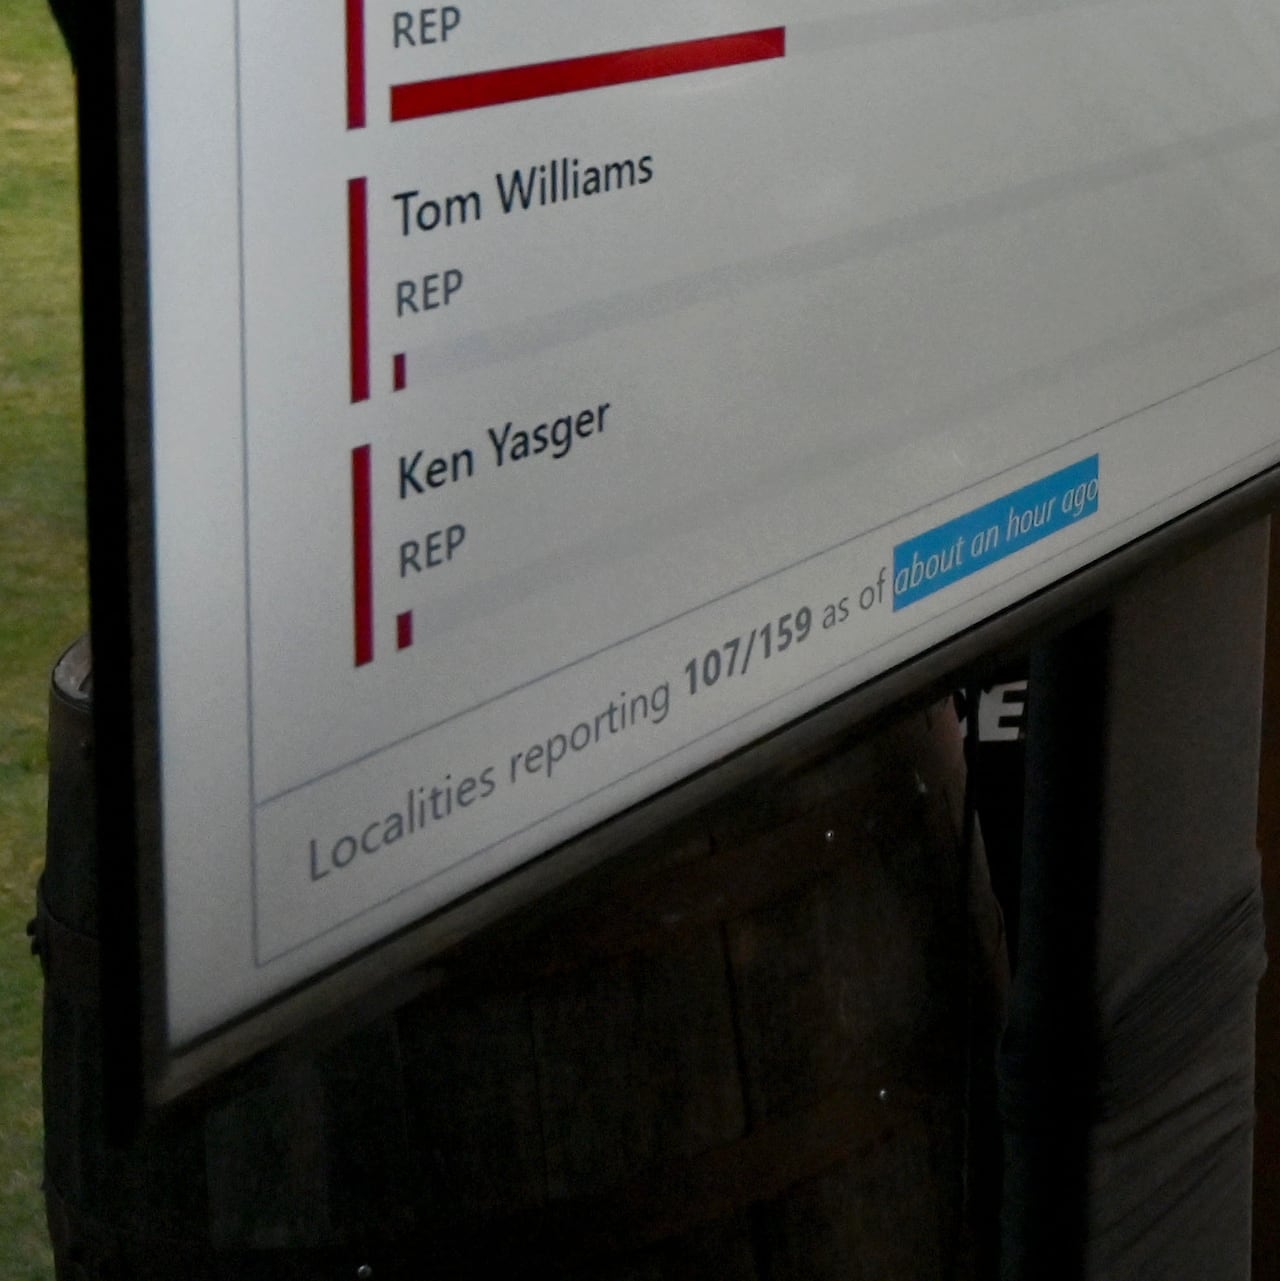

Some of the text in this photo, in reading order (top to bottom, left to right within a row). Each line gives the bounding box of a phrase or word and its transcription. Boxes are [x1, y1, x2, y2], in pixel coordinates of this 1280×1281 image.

[393, 5, 461, 48] REP
[393, 154, 653, 237] Tom Williams
[396, 268, 463, 317] REP
[399, 402, 610, 499] Ken Yasger
[399, 523, 466, 578] REP
[308, 477, 1098, 882] Localities reporting 107/159 as of about an hour ago
